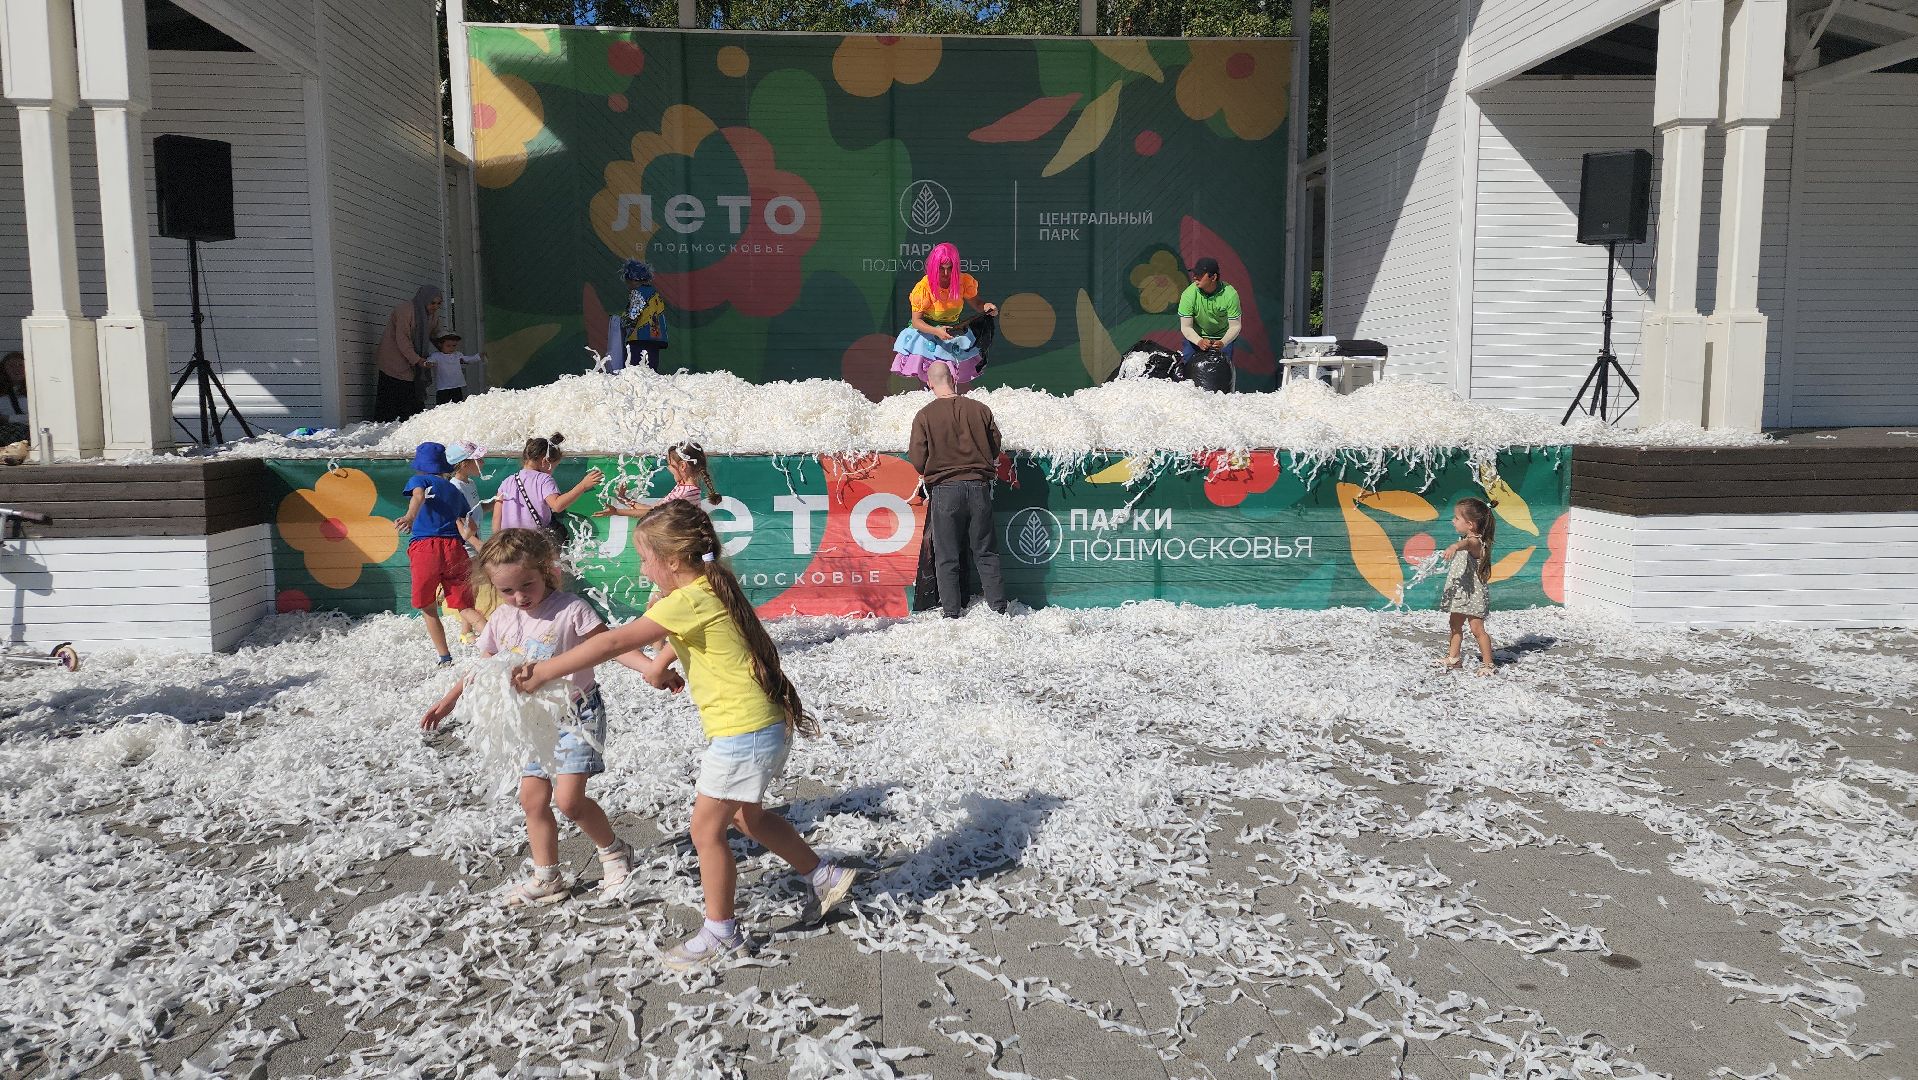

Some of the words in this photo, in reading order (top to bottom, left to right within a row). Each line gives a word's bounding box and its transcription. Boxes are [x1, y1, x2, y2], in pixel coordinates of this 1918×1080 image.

[1039, 210, 1153, 226] ЦЕНТРАЛЬНЫЙ
[1039, 228, 1080, 241] ПАРК
[635, 242, 644, 252] В
[653, 242, 785, 254] ПОДМОСКОВЬЕ
[899, 243, 936, 256] ПАР
[862, 258, 991, 272] ПОДМОВЬЯ
[1070, 508, 1173, 531] ПАРКИ
[1070, 536, 1314, 562] ПОДМОСКОВЬЯ
